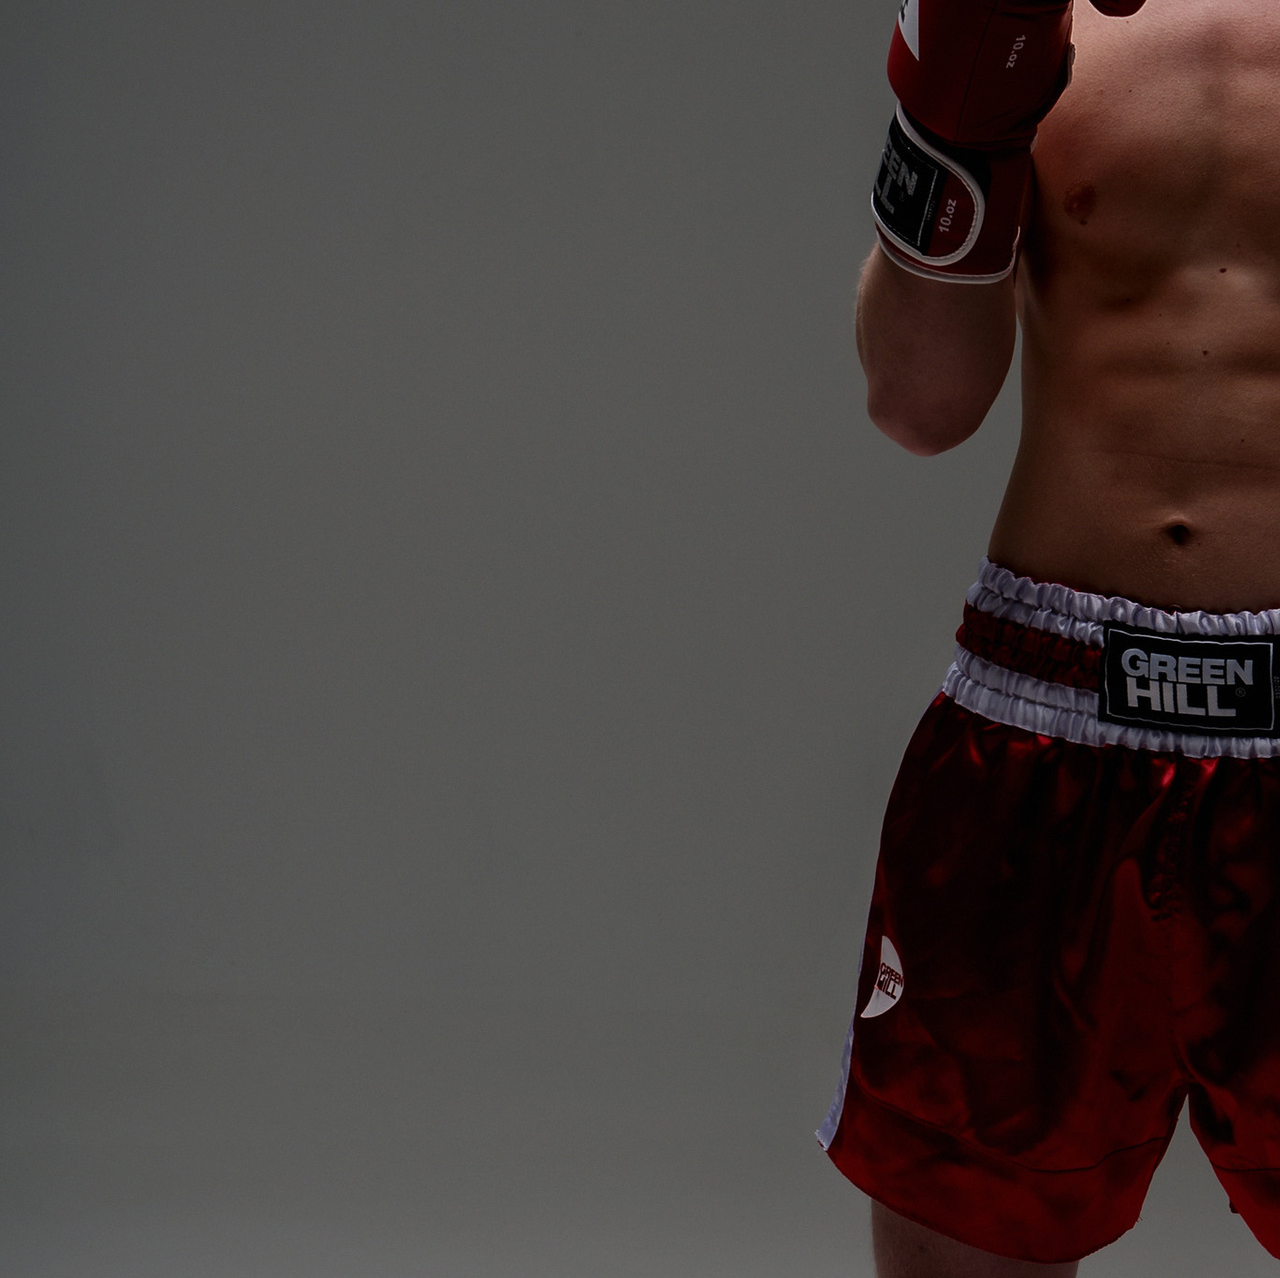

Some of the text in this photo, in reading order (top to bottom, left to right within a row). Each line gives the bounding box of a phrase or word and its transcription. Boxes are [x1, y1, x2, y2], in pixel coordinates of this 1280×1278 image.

[1005, 34, 1026, 69] 10.oz
[884, 138, 919, 197] EEN
[938, 198, 957, 233] 10.oz
[1120, 647, 1254, 686] GREEN
[1125, 675, 1237, 717] HILL
